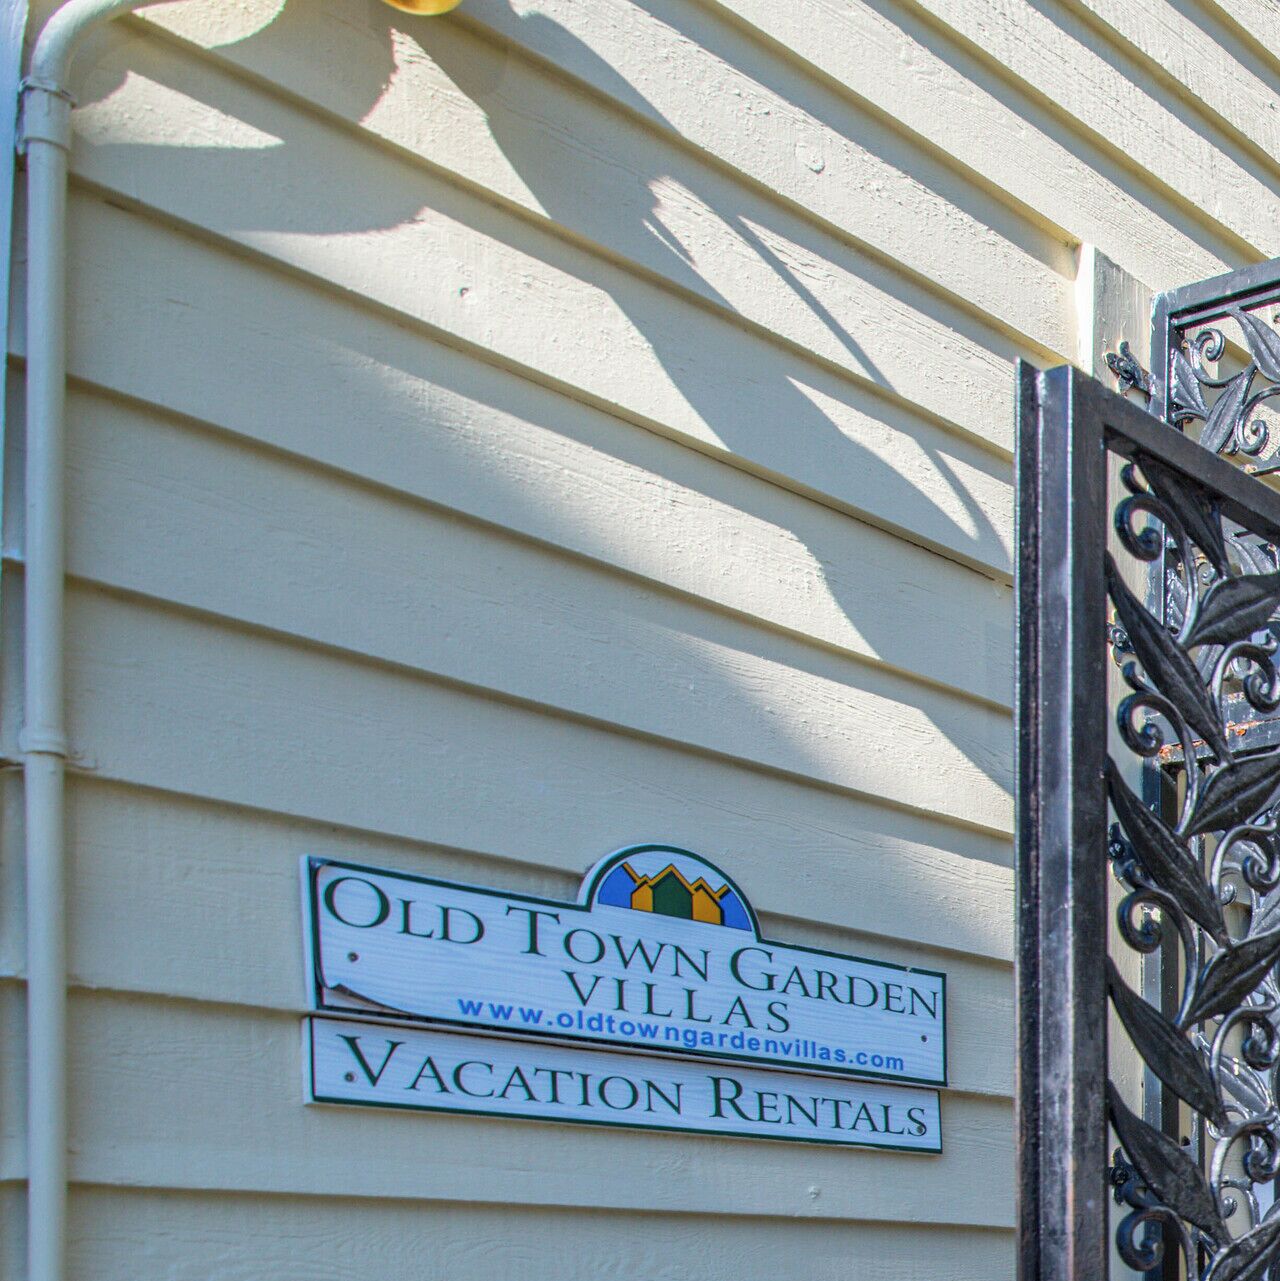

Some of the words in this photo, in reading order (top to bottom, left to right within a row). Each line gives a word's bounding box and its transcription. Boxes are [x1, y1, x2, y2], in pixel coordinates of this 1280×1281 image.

[323, 876, 485, 946] OLD
[505, 905, 711, 983] TOWN
[729, 946, 938, 1020] GARDEN
[457, 997, 905, 1072] www.oldtowngardenvillas.com
[561, 968, 792, 1034] VILLAS
[336, 1032, 684, 1116] VACATION
[707, 1075, 929, 1138] RENTALS
